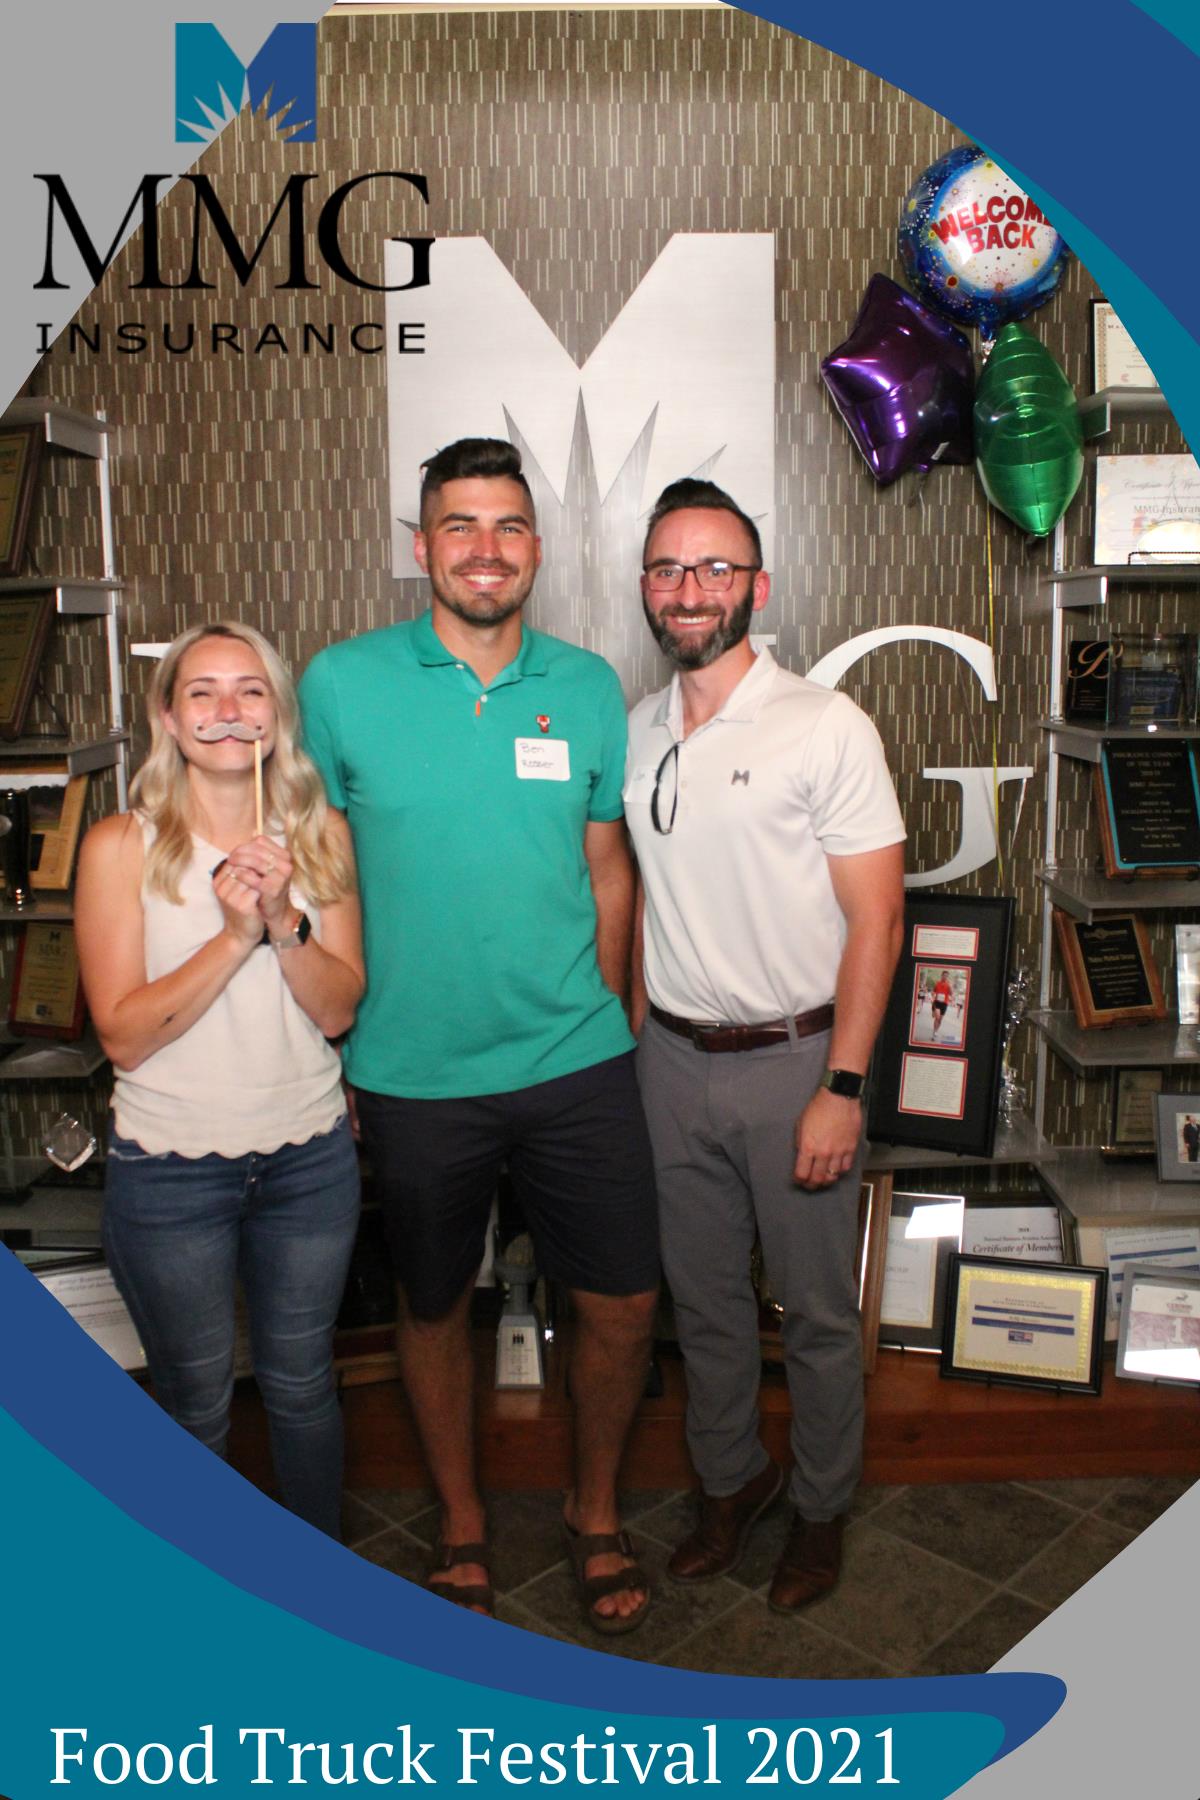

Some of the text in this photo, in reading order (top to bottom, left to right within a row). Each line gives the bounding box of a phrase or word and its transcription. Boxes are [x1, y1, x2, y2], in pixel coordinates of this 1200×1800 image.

[931, 195, 1053, 245] WELCOM
[966, 222, 1036, 254] BACK
[973, 1243, 1015, 1255] Certificate
